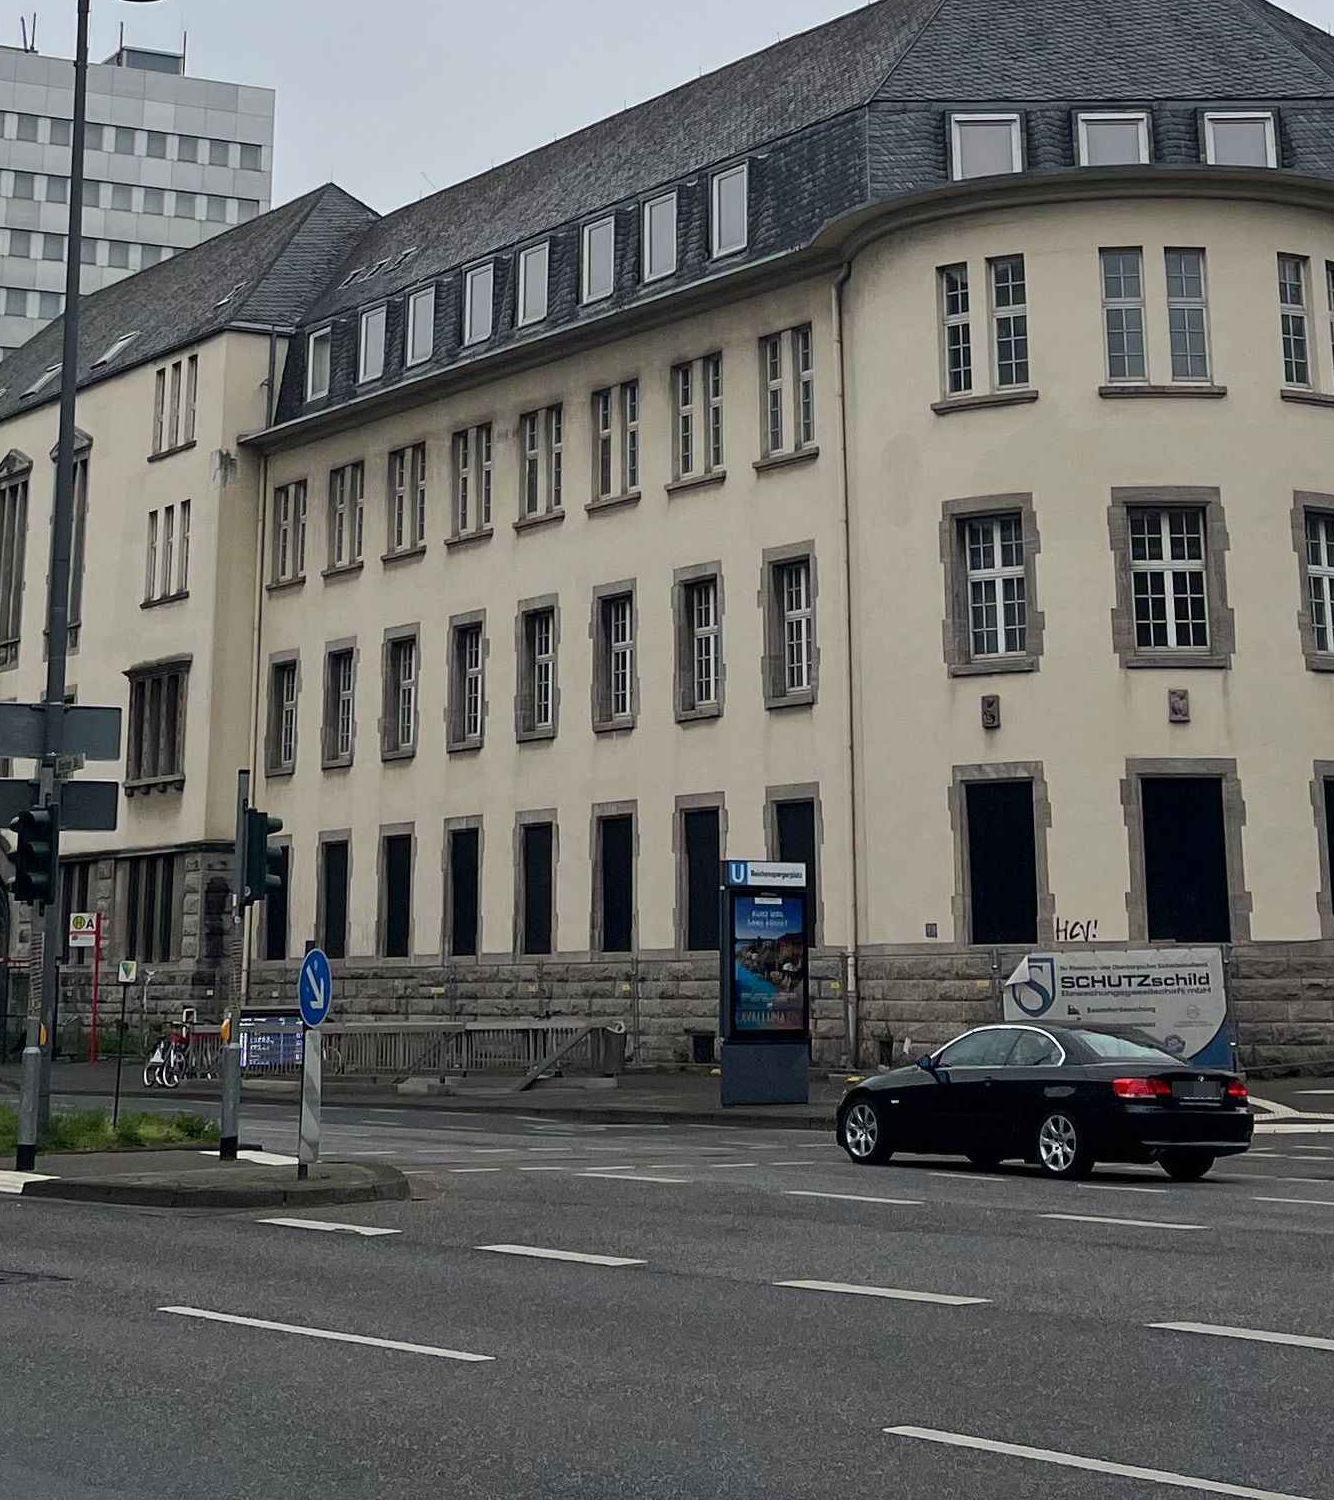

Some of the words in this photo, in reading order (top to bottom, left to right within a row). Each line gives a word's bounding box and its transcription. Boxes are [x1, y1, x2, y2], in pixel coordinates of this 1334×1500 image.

[731, 863, 745, 883] U
[86, 918, 95, 929] A
[1061, 972, 1210, 988] SCHUTZschild
[1062, 988, 1186, 998] Bewachungsgesellschaft
[1187, 986, 1211, 994] mbH
